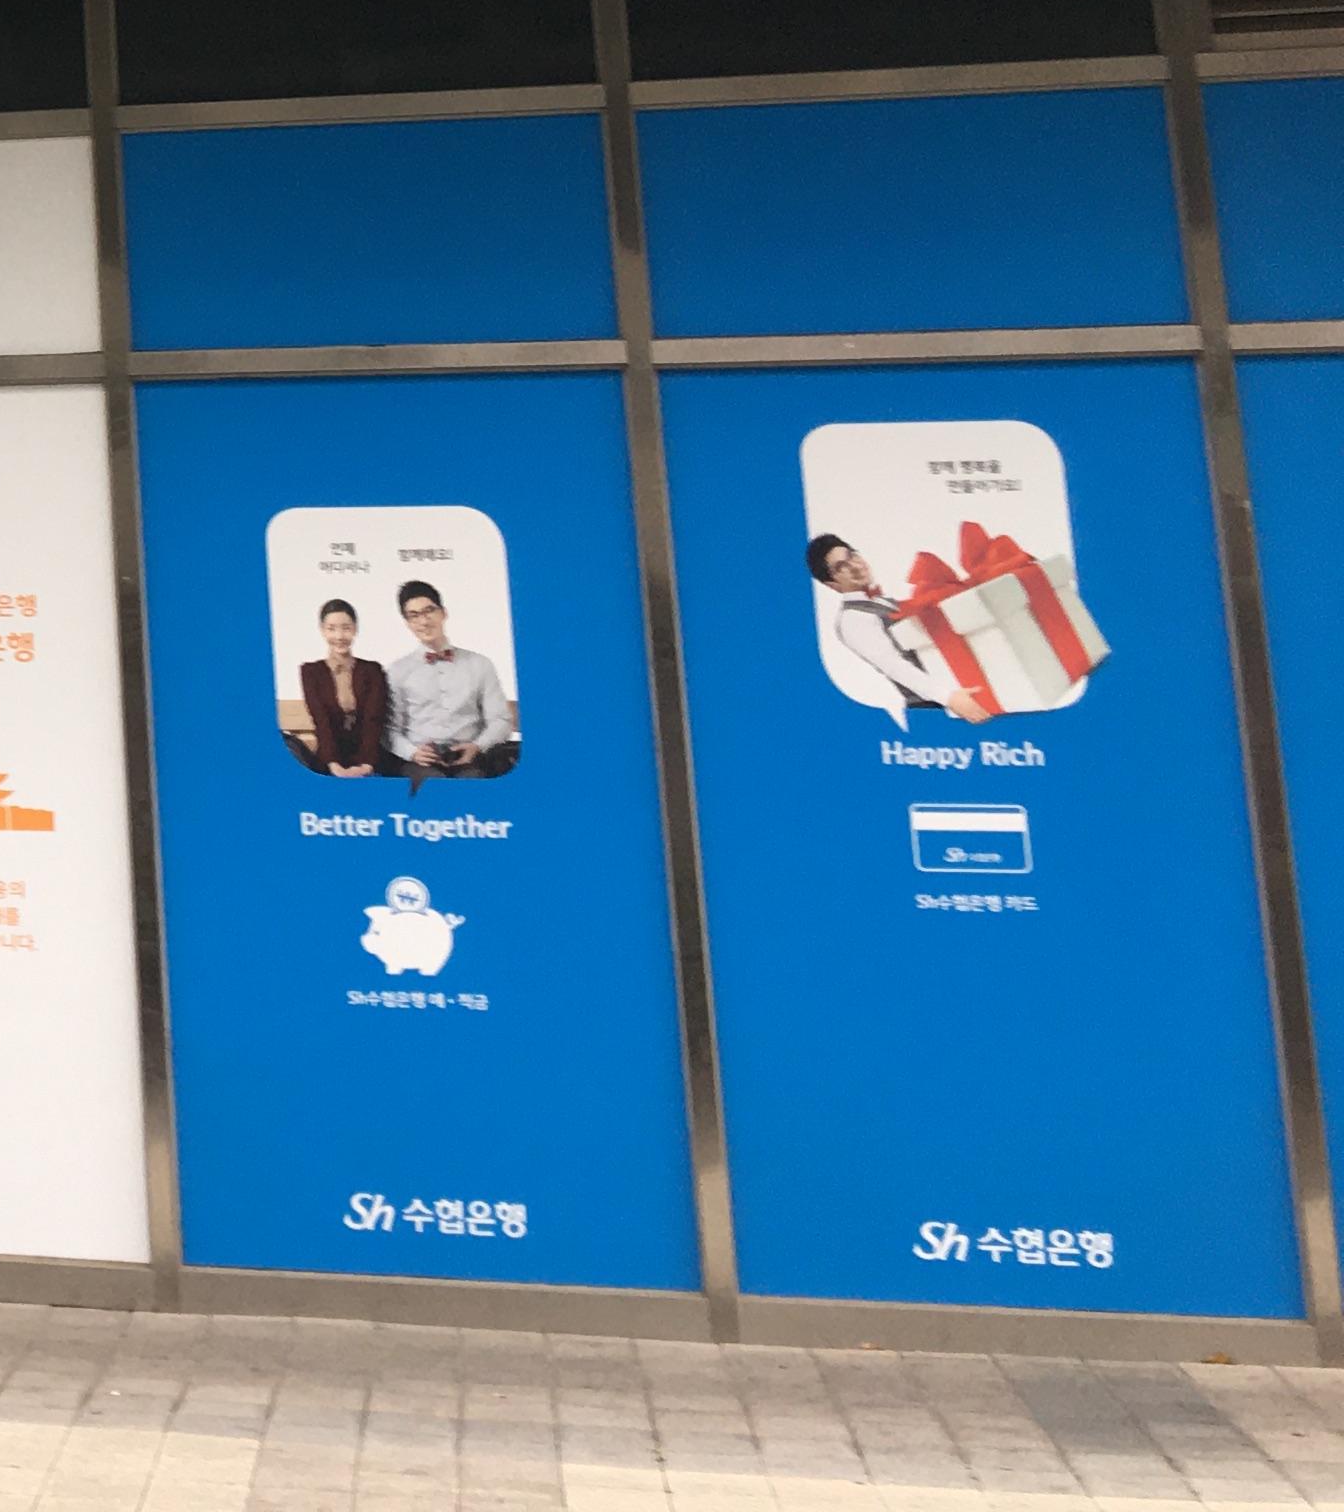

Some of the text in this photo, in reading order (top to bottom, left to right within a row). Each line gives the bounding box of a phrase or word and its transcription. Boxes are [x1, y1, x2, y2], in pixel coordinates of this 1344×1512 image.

[880, 741, 1046, 771] Happy Rich
[299, 812, 513, 843] Better Together
[343, 1192, 527, 1239] Sh 수협은행
[914, 1221, 1114, 1269] Sh 수협은행
